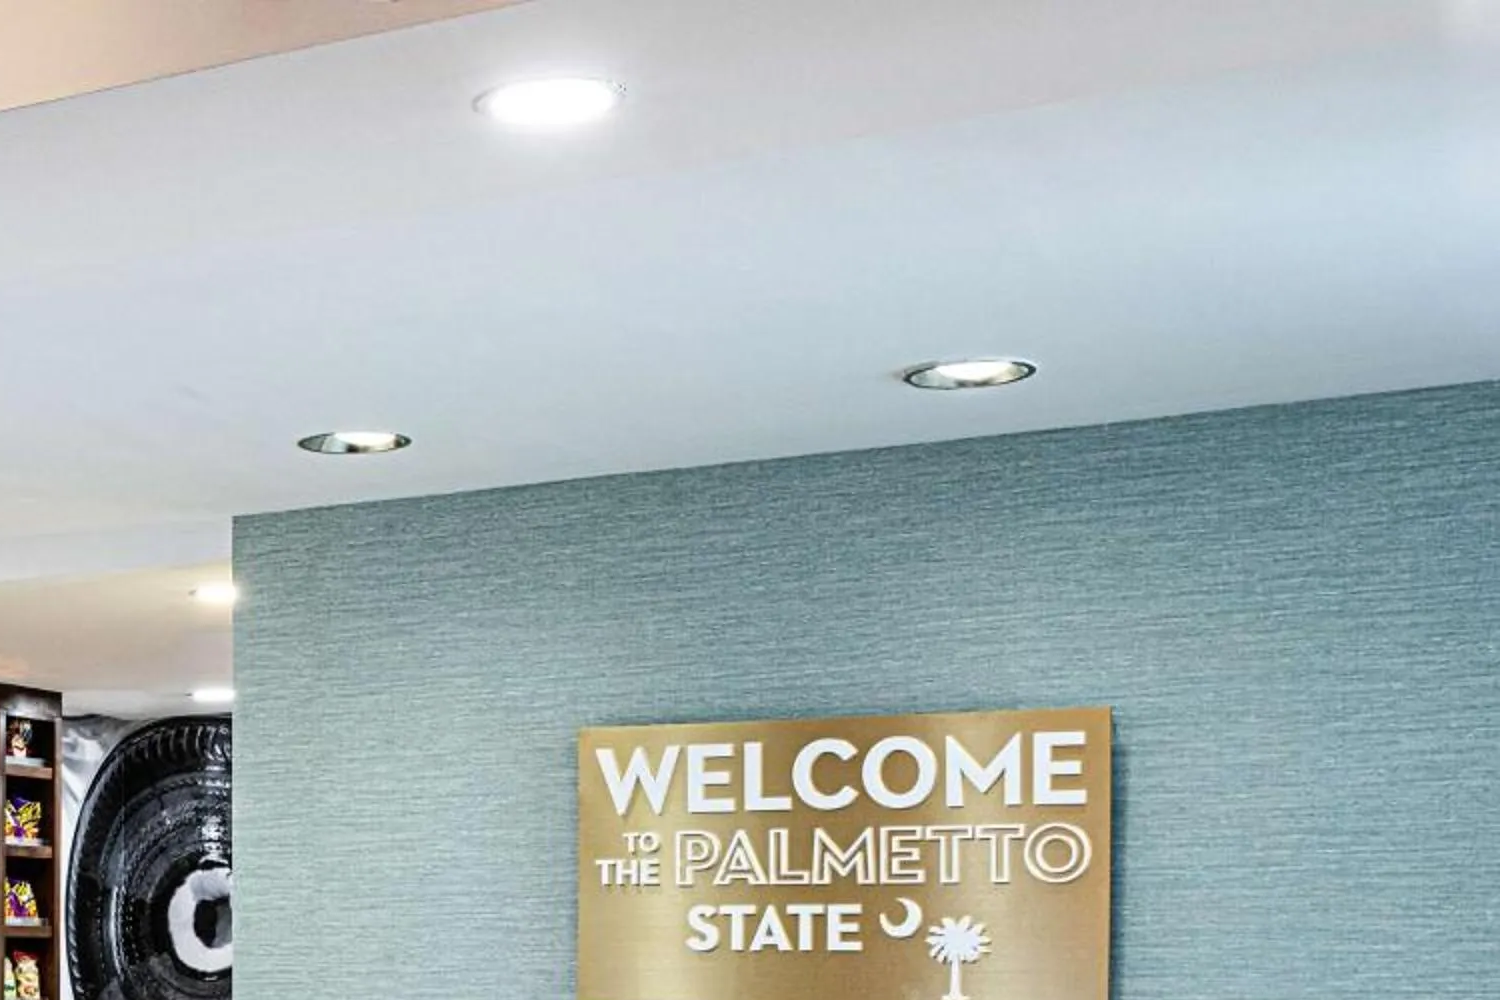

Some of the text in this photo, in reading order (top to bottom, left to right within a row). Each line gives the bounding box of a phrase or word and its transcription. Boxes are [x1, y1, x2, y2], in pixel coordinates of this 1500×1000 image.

[595, 731, 1088, 816] WELCOME
[596, 823, 1092, 887] THE PALMETTO
[623, 831, 660, 853] TO
[685, 903, 863, 952] STATE
